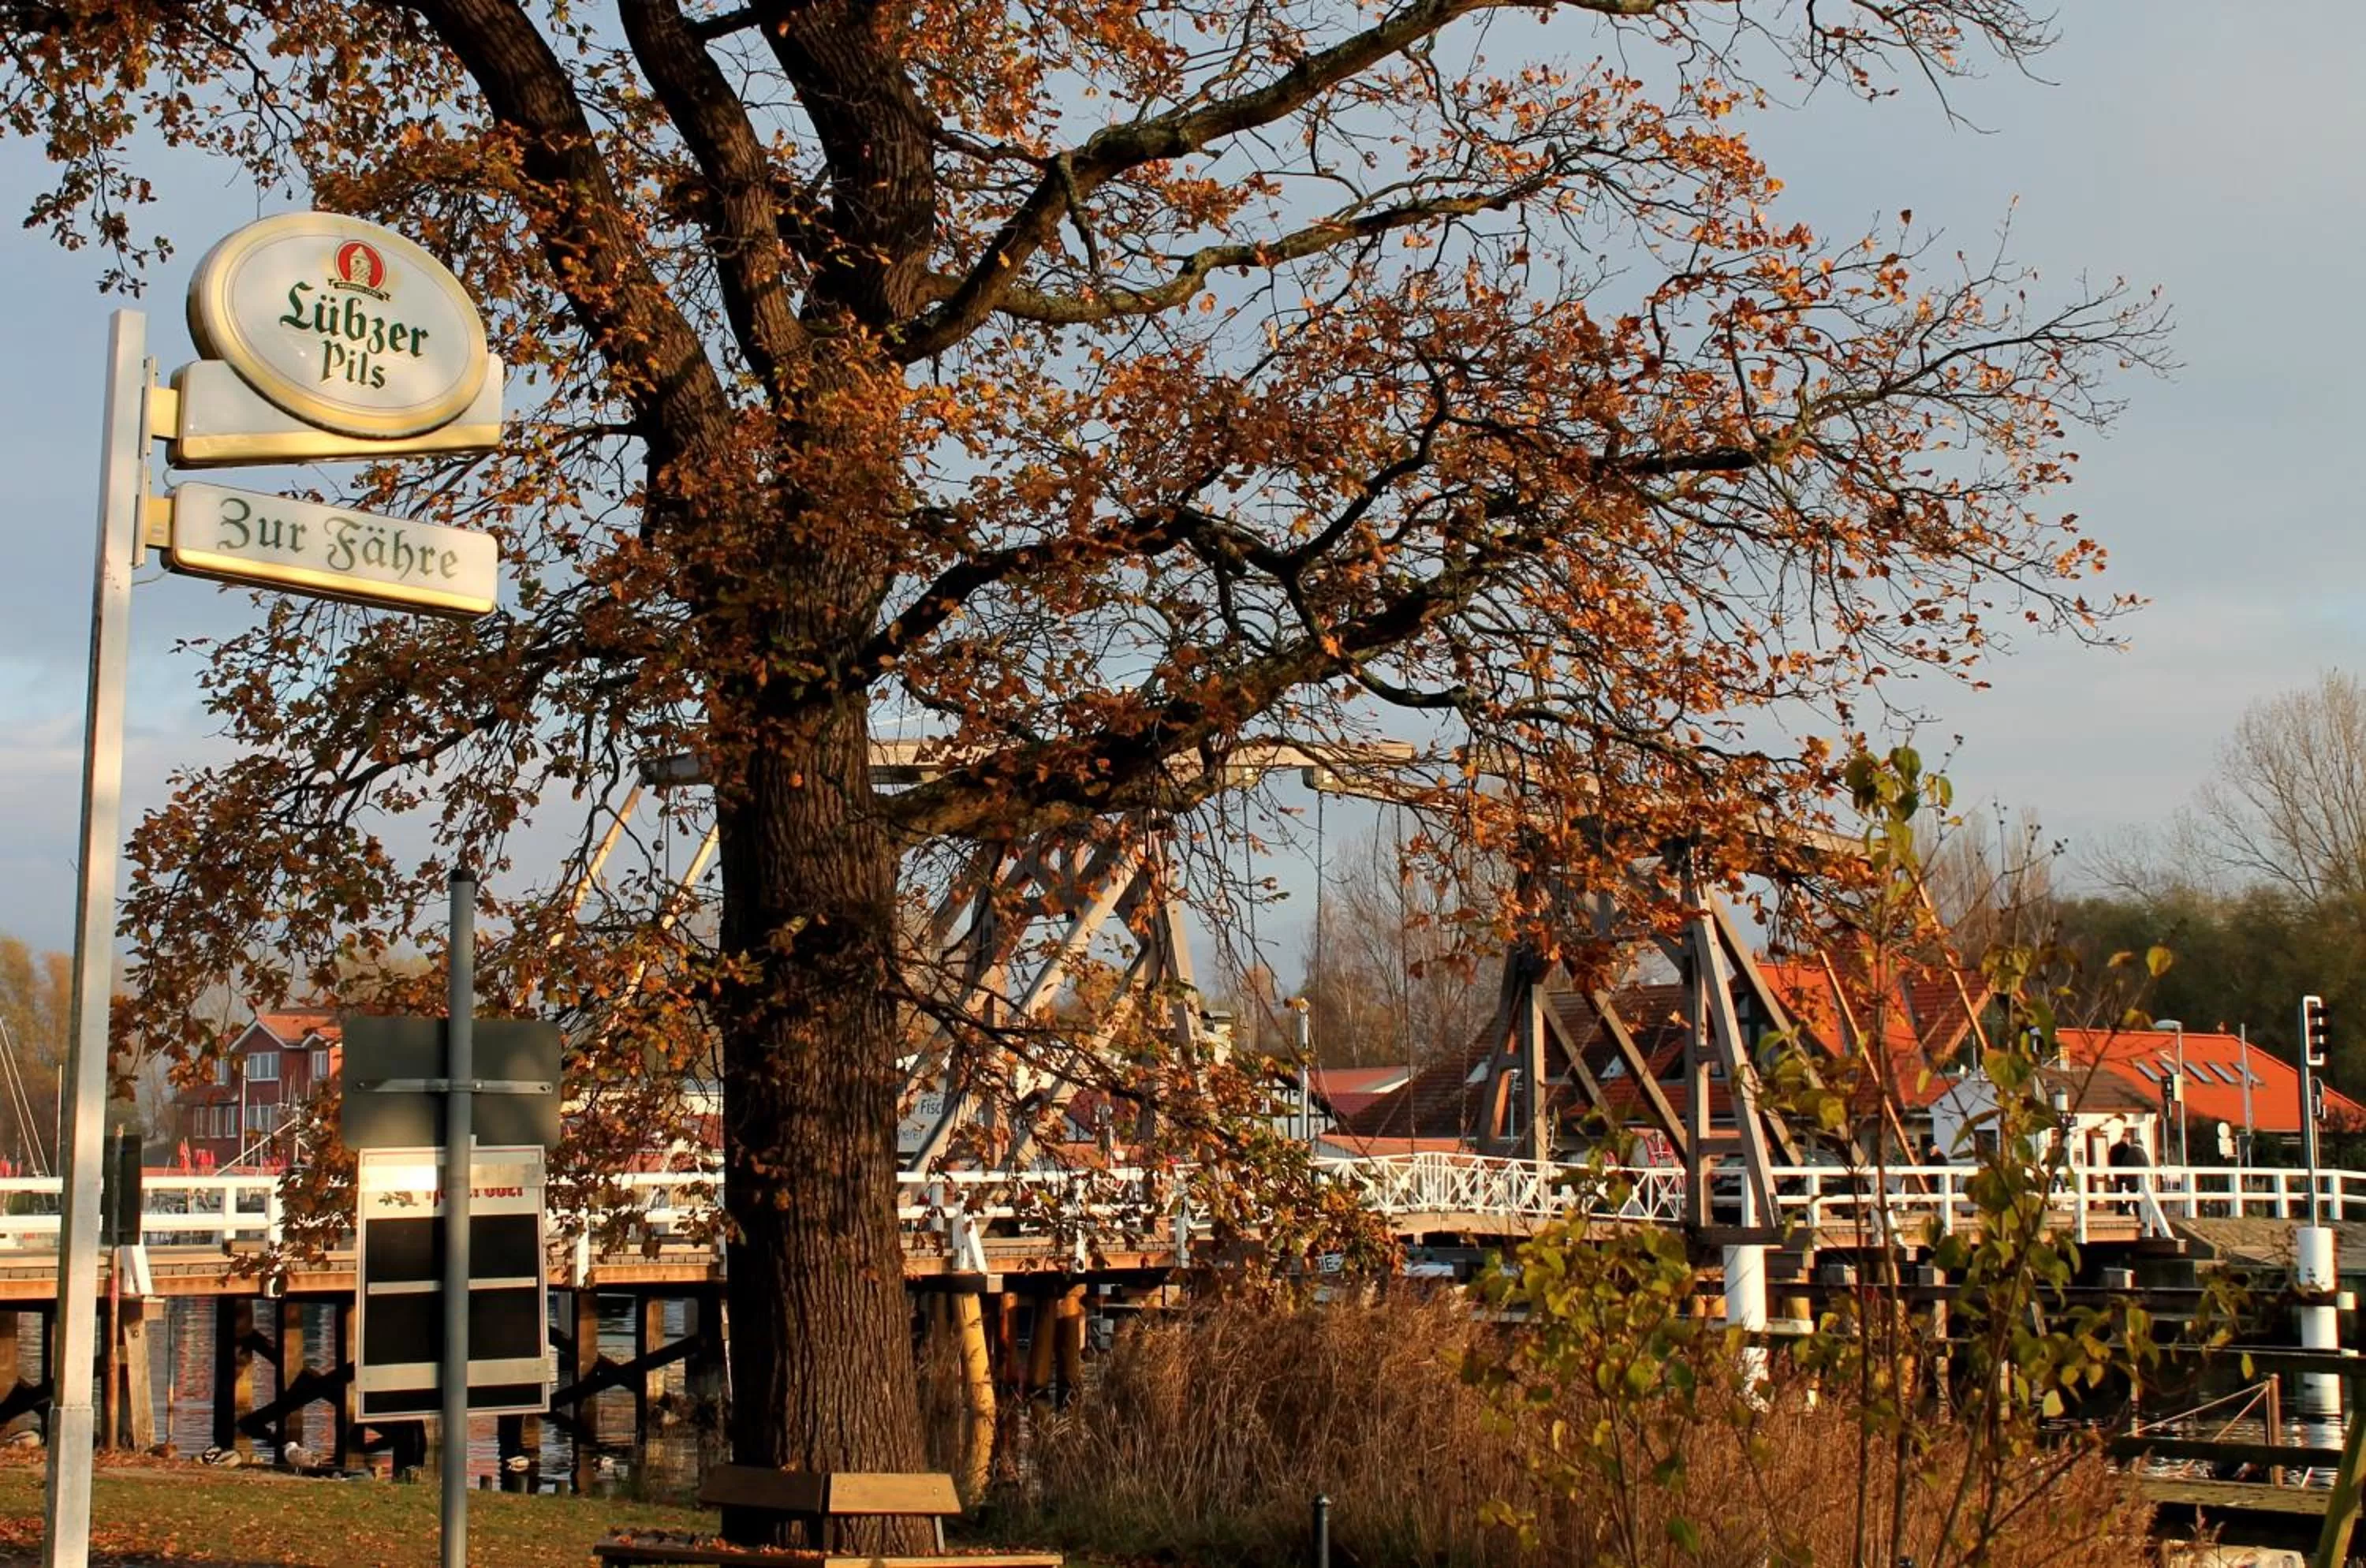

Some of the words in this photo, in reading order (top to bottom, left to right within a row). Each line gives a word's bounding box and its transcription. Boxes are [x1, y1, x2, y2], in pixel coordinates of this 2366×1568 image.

[279, 281, 430, 358] Lübzer
[320, 340, 386, 390] Pils
[217, 498, 308, 553] Zur
[324, 517, 460, 581] Fähre
